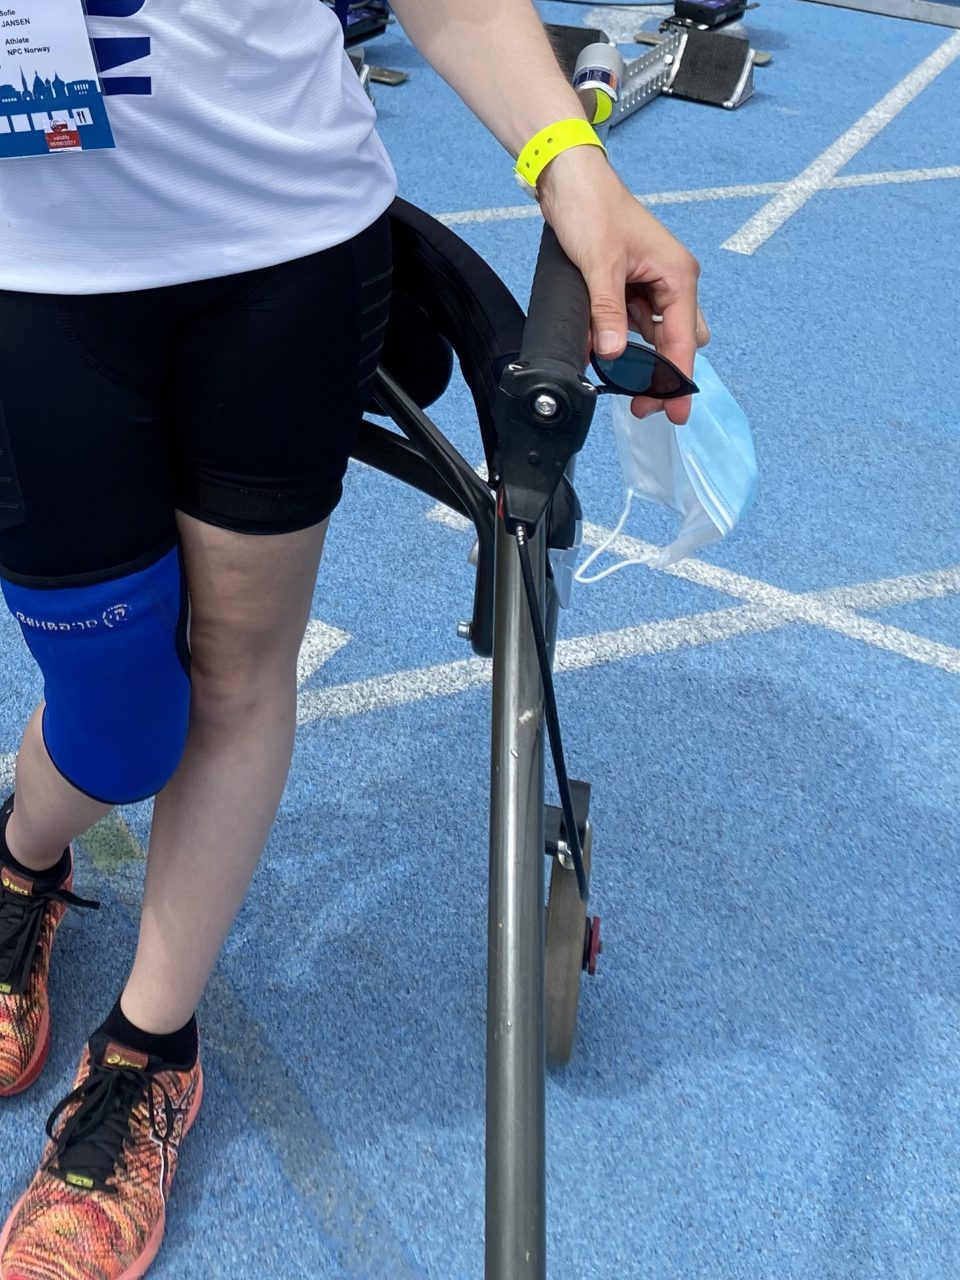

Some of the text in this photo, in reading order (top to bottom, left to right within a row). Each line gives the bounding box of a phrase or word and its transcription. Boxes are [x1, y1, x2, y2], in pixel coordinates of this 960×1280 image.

[0, 9, 16, 17] Sofie
[1, 17, 31, 28] JANSEN
[5, 37, 30, 45] Athlete
[7, 46, 51, 56] NPC Norway
